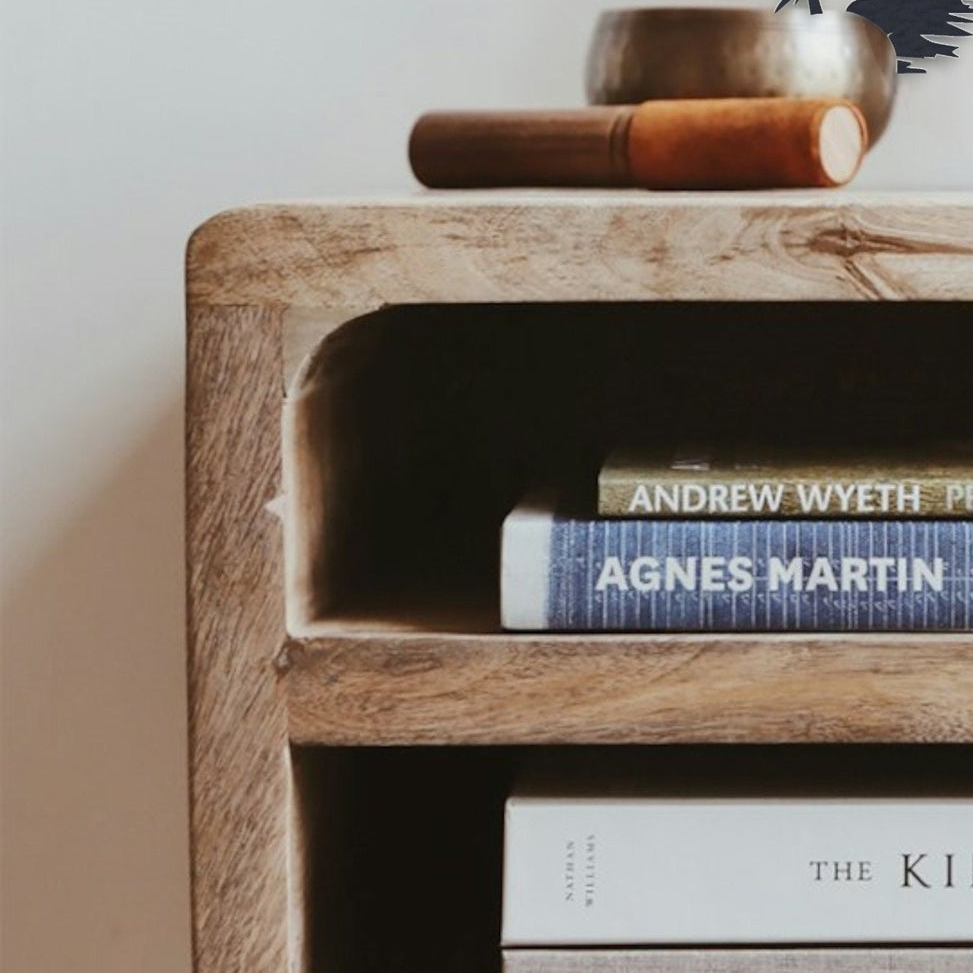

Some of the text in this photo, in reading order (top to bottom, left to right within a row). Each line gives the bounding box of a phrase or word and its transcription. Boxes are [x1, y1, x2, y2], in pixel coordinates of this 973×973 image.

[628, 483, 785, 513] ANDREW
[796, 483, 921, 513] WYETH
[595, 555, 944, 592] AGNES MARTIN
[564, 840, 575, 903] NATHAN
[585, 833, 596, 908] WILLIAMS
[808, 860, 874, 882] THE
